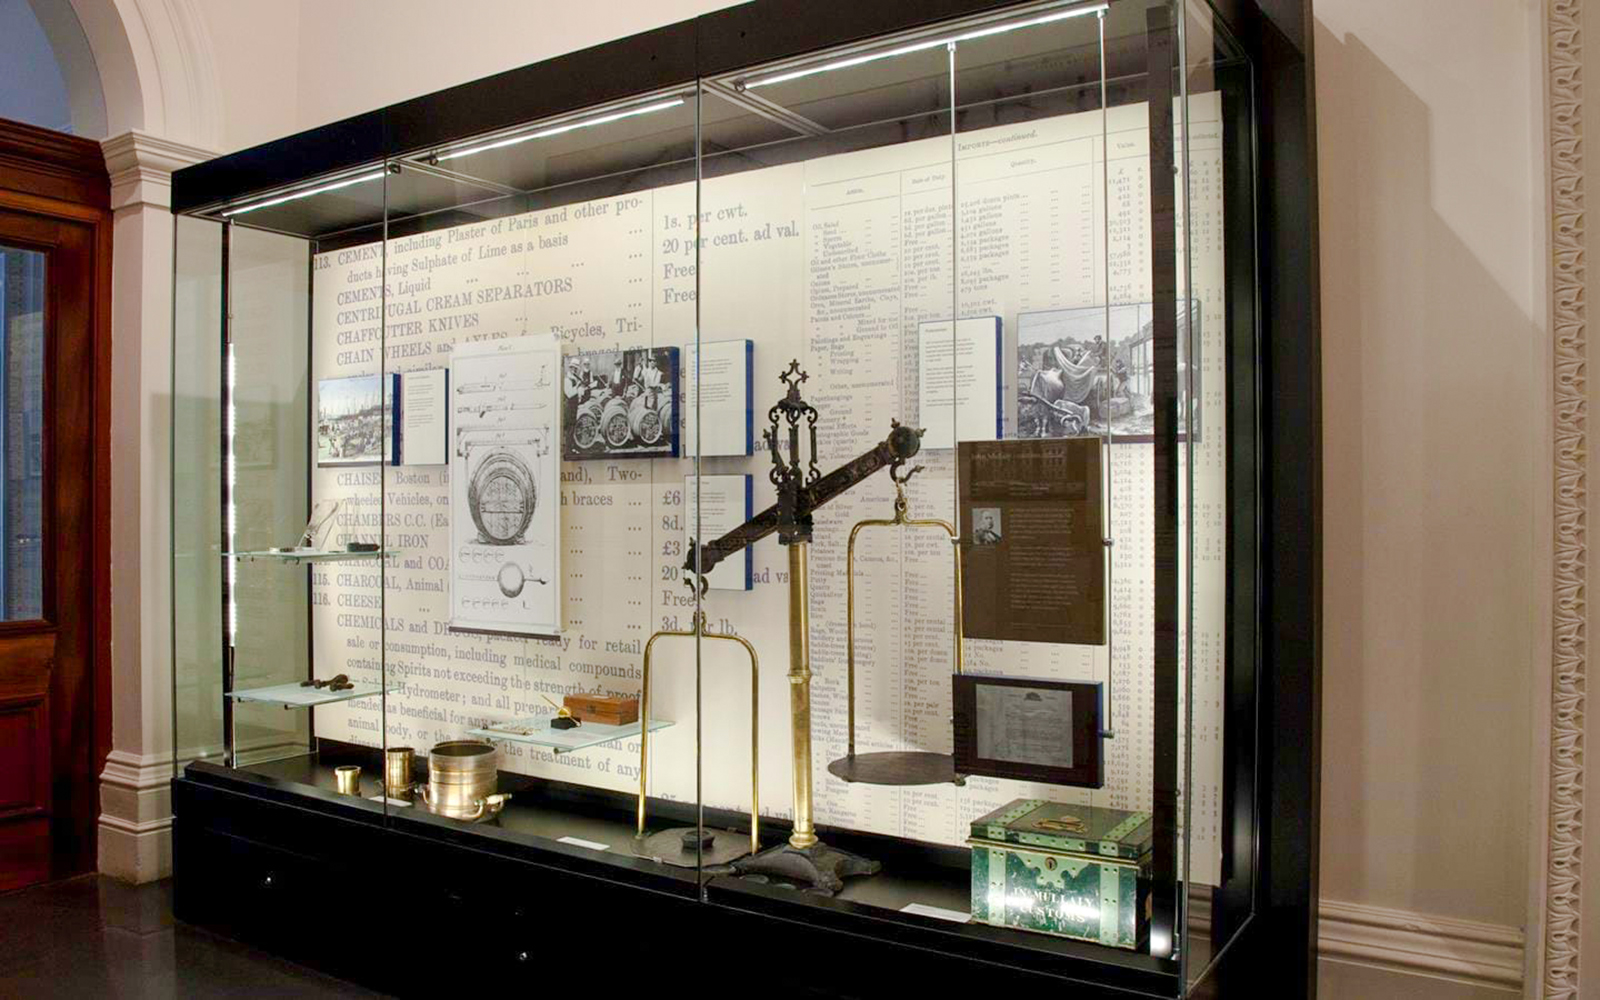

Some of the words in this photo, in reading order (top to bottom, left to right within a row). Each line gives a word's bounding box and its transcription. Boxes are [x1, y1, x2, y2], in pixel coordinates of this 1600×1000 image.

[664, 215, 681, 230] 1s.
[717, 202, 748, 220] cwt.
[314, 255, 331, 270] 113.
[394, 234, 441, 254] including
[448, 226, 485, 244] Plaster
[491, 219, 503, 235] of
[508, 215, 539, 233] Paris
[545, 208, 568, 226] and
[574, 203, 609, 220] other
[616, 197, 643, 215] pro-
[662, 238, 679, 254] 20
[713, 228, 748, 247] cent.
[753, 222, 771, 240] ad
[776, 220, 800, 238] val.
[347, 269, 372, 284] ducts
[375, 262, 408, 281] hving
[411, 253, 458, 273] Sulphate
[461, 249, 473, 262] of
[477, 243, 508, 261] Lime
[510, 242, 523, 254] as
[526, 240, 534, 251] a
[538, 232, 569, 250] basis
[663, 262, 696, 280] Free
[337, 283, 394, 306] CEMENTS,
[398, 277, 431, 297] Liquid
[426, 291, 473, 312] CREAM
[476, 277, 573, 305] SEPARATORS
[663, 287, 696, 304] Free
[337, 320, 423, 346] CHAFFCUTTER
[428, 313, 479, 334] KNIVES
[337, 348, 374, 366] CHAIN
[616, 317, 642, 334] Tri-
[337, 471, 381, 486] CHAISE
[395, 470, 430, 486] Boston
[607, 465, 642, 481] Two-
[387, 492, 433, 507] Vehicles,
[573, 491, 613, 506] braces
[662, 490, 681, 506] £6
[404, 512, 427, 528] C.C.
[662, 515, 684, 532] 8d.
[336, 532, 393, 548] CHANNL
[398, 533, 429, 549] IRON
[662, 540, 681, 556] £3
[404, 555, 423, 570] and
[662, 565, 679, 582] 20
[753, 567, 770, 584] ad
[313, 573, 330, 587] 115.
[337, 573, 401, 592] CHARCOAL,
[406, 578, 444, 593] Animal
[313, 592, 331, 606] 116.
[337, 593, 383, 609] CHEESE
[662, 590, 695, 607] Free
[661, 615, 684, 632] 3d.
[337, 613, 405, 632] CHEMICALS
[408, 619, 428, 634] and
[578, 634, 598, 650] for
[605, 638, 642, 656] retail
[347, 635, 365, 648] sale
[369, 639, 381, 651] or
[384, 641, 452, 660] consumption,
[455, 645, 507, 667] including
[514, 653, 561, 671] medical
[569, 661, 642, 680] compounds
[347, 656, 396, 676] containng
[398, 661, 432, 679] Spirits
[433, 665, 451, 681] not
[454, 667, 508, 692] exceeding
[510, 672, 530, 690] the
[534, 677, 585, 696] strength
[471, 694, 491, 709] and
[495, 695, 510, 711] all
[400, 701, 447, 723] beneficial
[450, 709, 466, 725] for
[347, 717, 379, 732] animal
[417, 729, 429, 740] or
[504, 741, 523, 757] the
[530, 746, 591, 770] treatment
[597, 757, 614, 774] of
[617, 763, 641, 781] any
